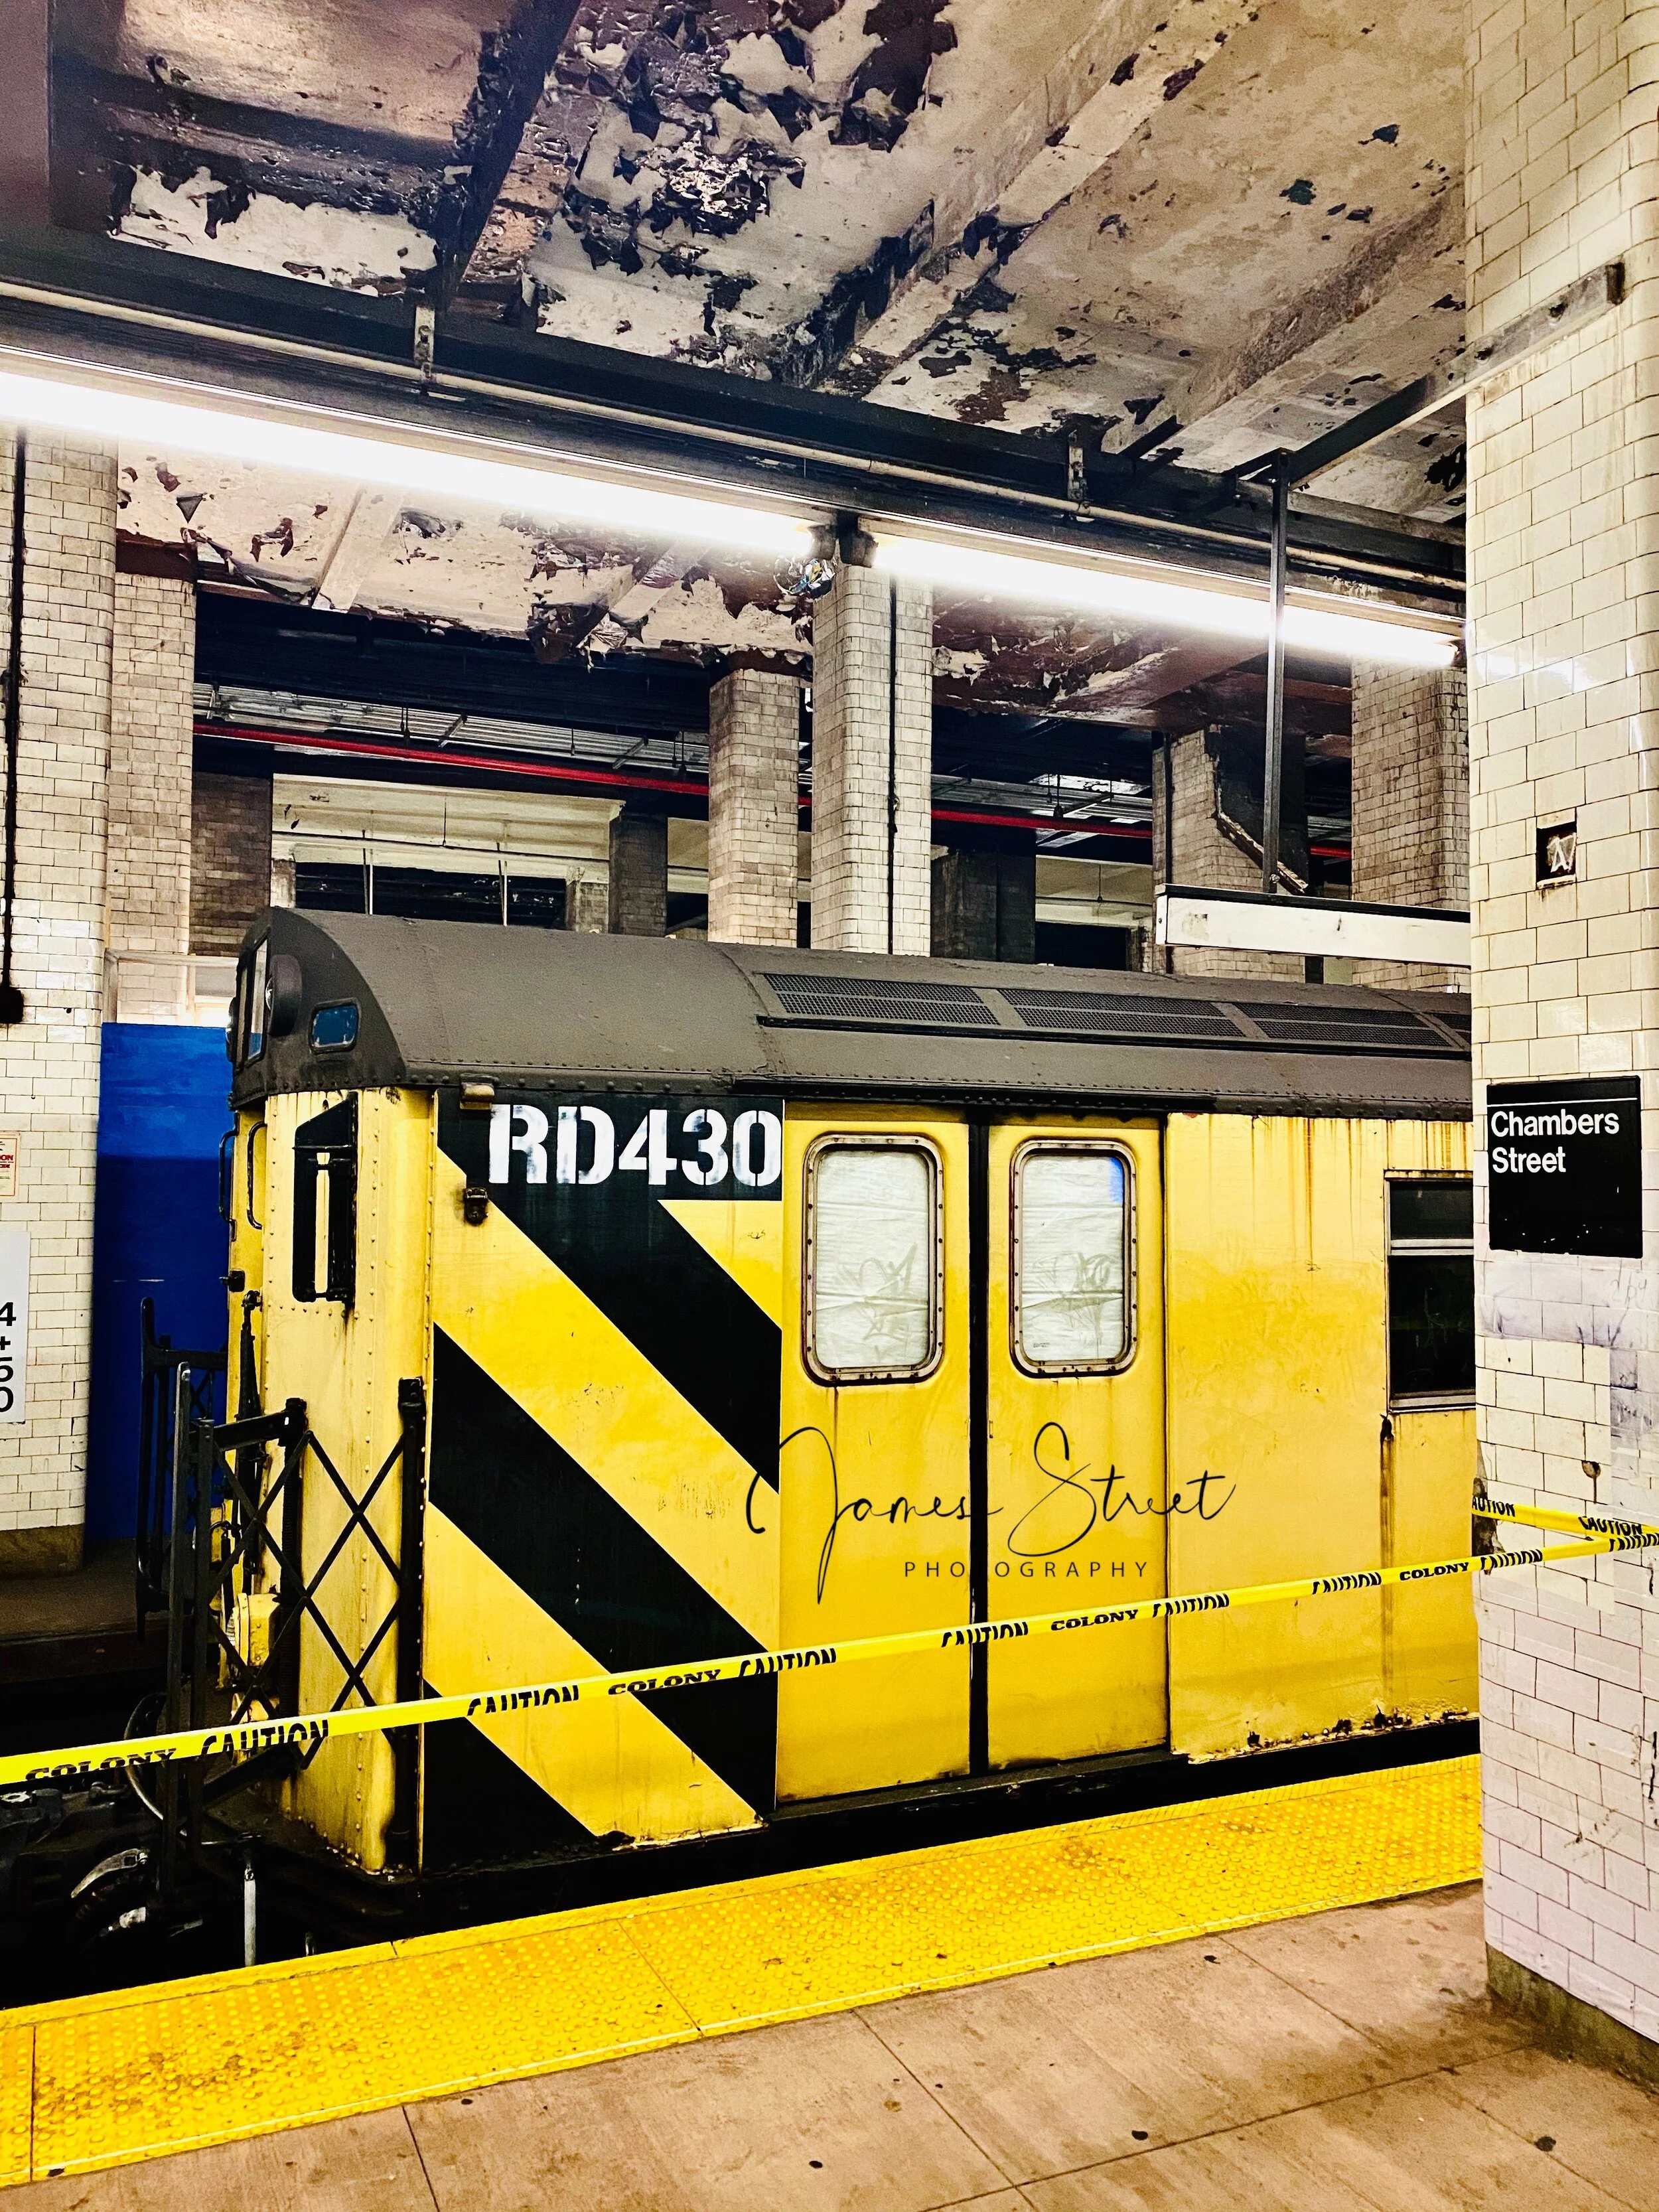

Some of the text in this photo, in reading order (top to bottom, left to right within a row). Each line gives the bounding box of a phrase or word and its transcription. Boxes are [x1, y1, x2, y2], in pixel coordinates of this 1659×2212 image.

[1490, 1108, 1620, 1138] Chambers
[488, 1104, 782, 1187] RD430
[1492, 1146, 1567, 1173] Street
[1471, 1496, 1642, 1536] AUTION CAUTION
[25, 1748, 177, 1781] COLONY
[201, 1719, 329, 1755] CAUTION
[467, 1684, 579, 1716] CAUTION
[607, 1668, 722, 1696] COLONY
[738, 1648, 837, 1678] CAUTION
[941, 1621, 1029, 1647] CAUTION
[1050, 1609, 1139, 1631] COLONY
[1152, 1593, 1230, 1618] CAUTION
[1312, 1572, 1382, 1595] CAUTION
[1399, 1562, 1469, 1582] COLONY
